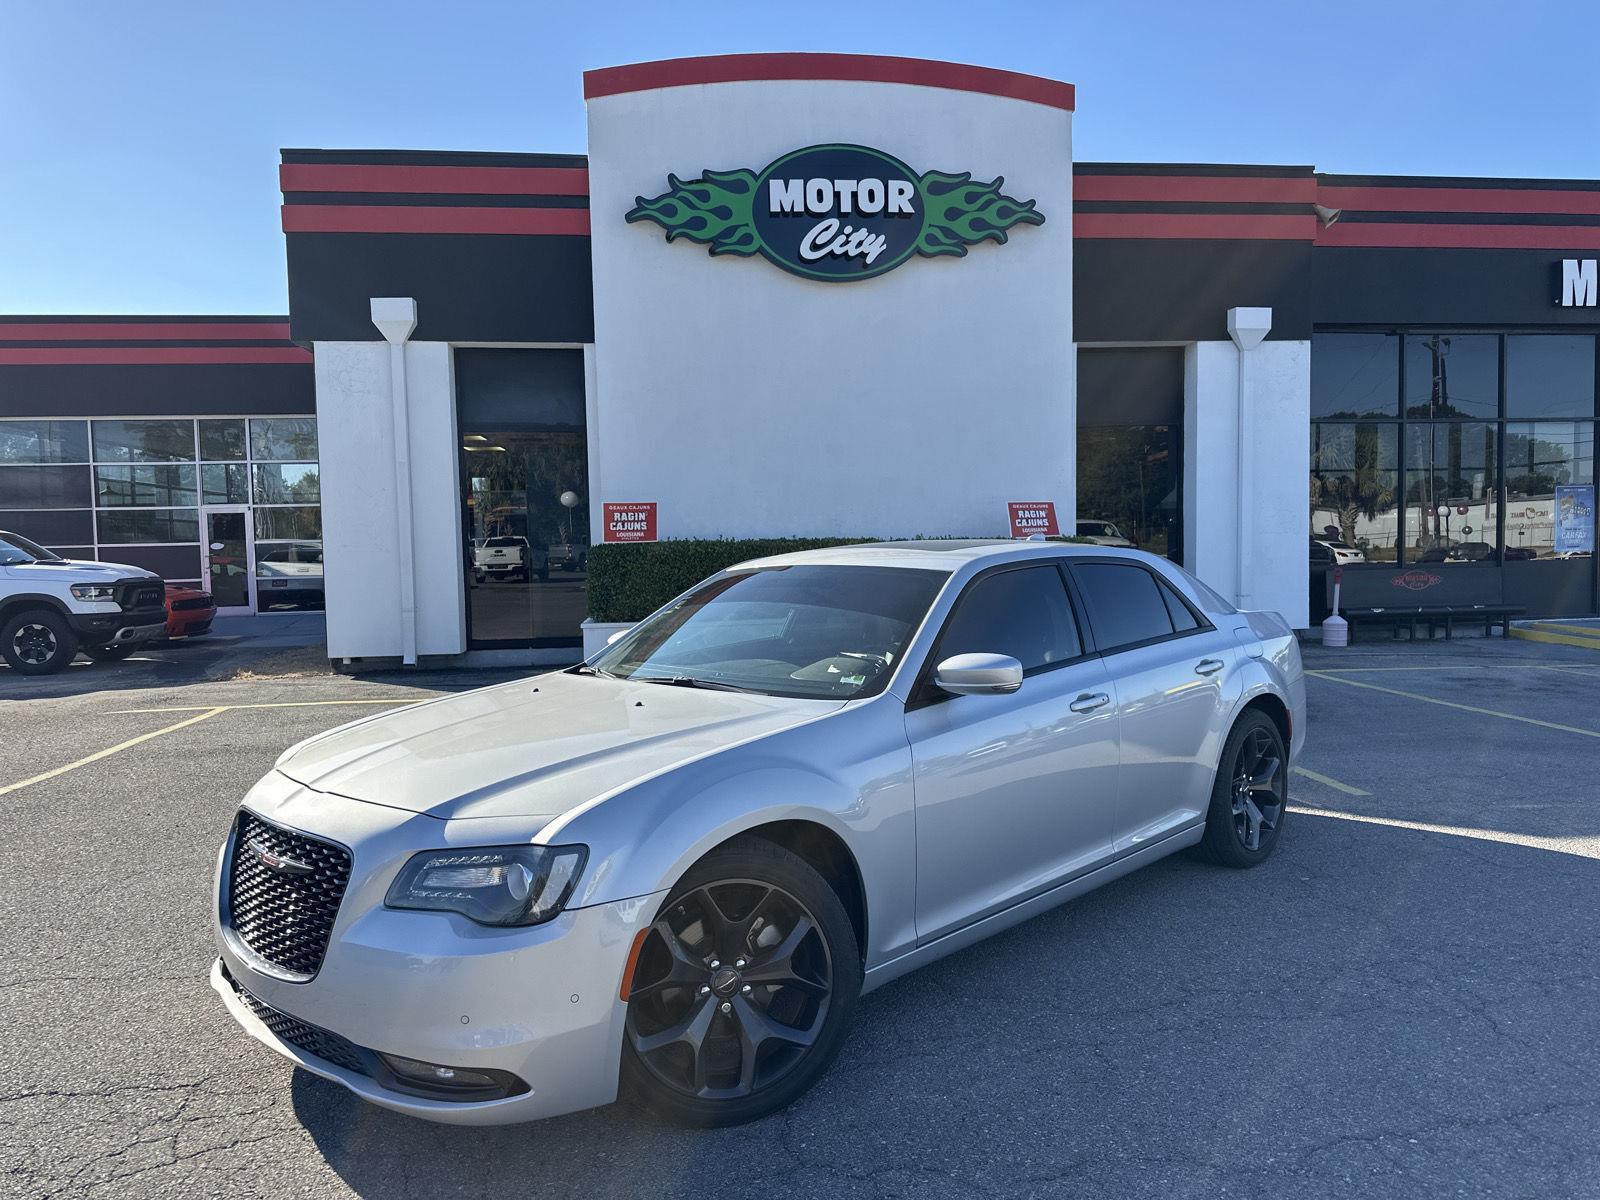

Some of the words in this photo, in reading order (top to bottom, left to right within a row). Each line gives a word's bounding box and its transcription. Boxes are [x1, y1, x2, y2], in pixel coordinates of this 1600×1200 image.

[769, 178, 915, 213] MOTOR
[800, 218, 887, 265] City
[1562, 259, 1598, 307] M
[610, 522, 648, 531] CAJUNS
[1016, 518, 1049, 527] CAJUNS
